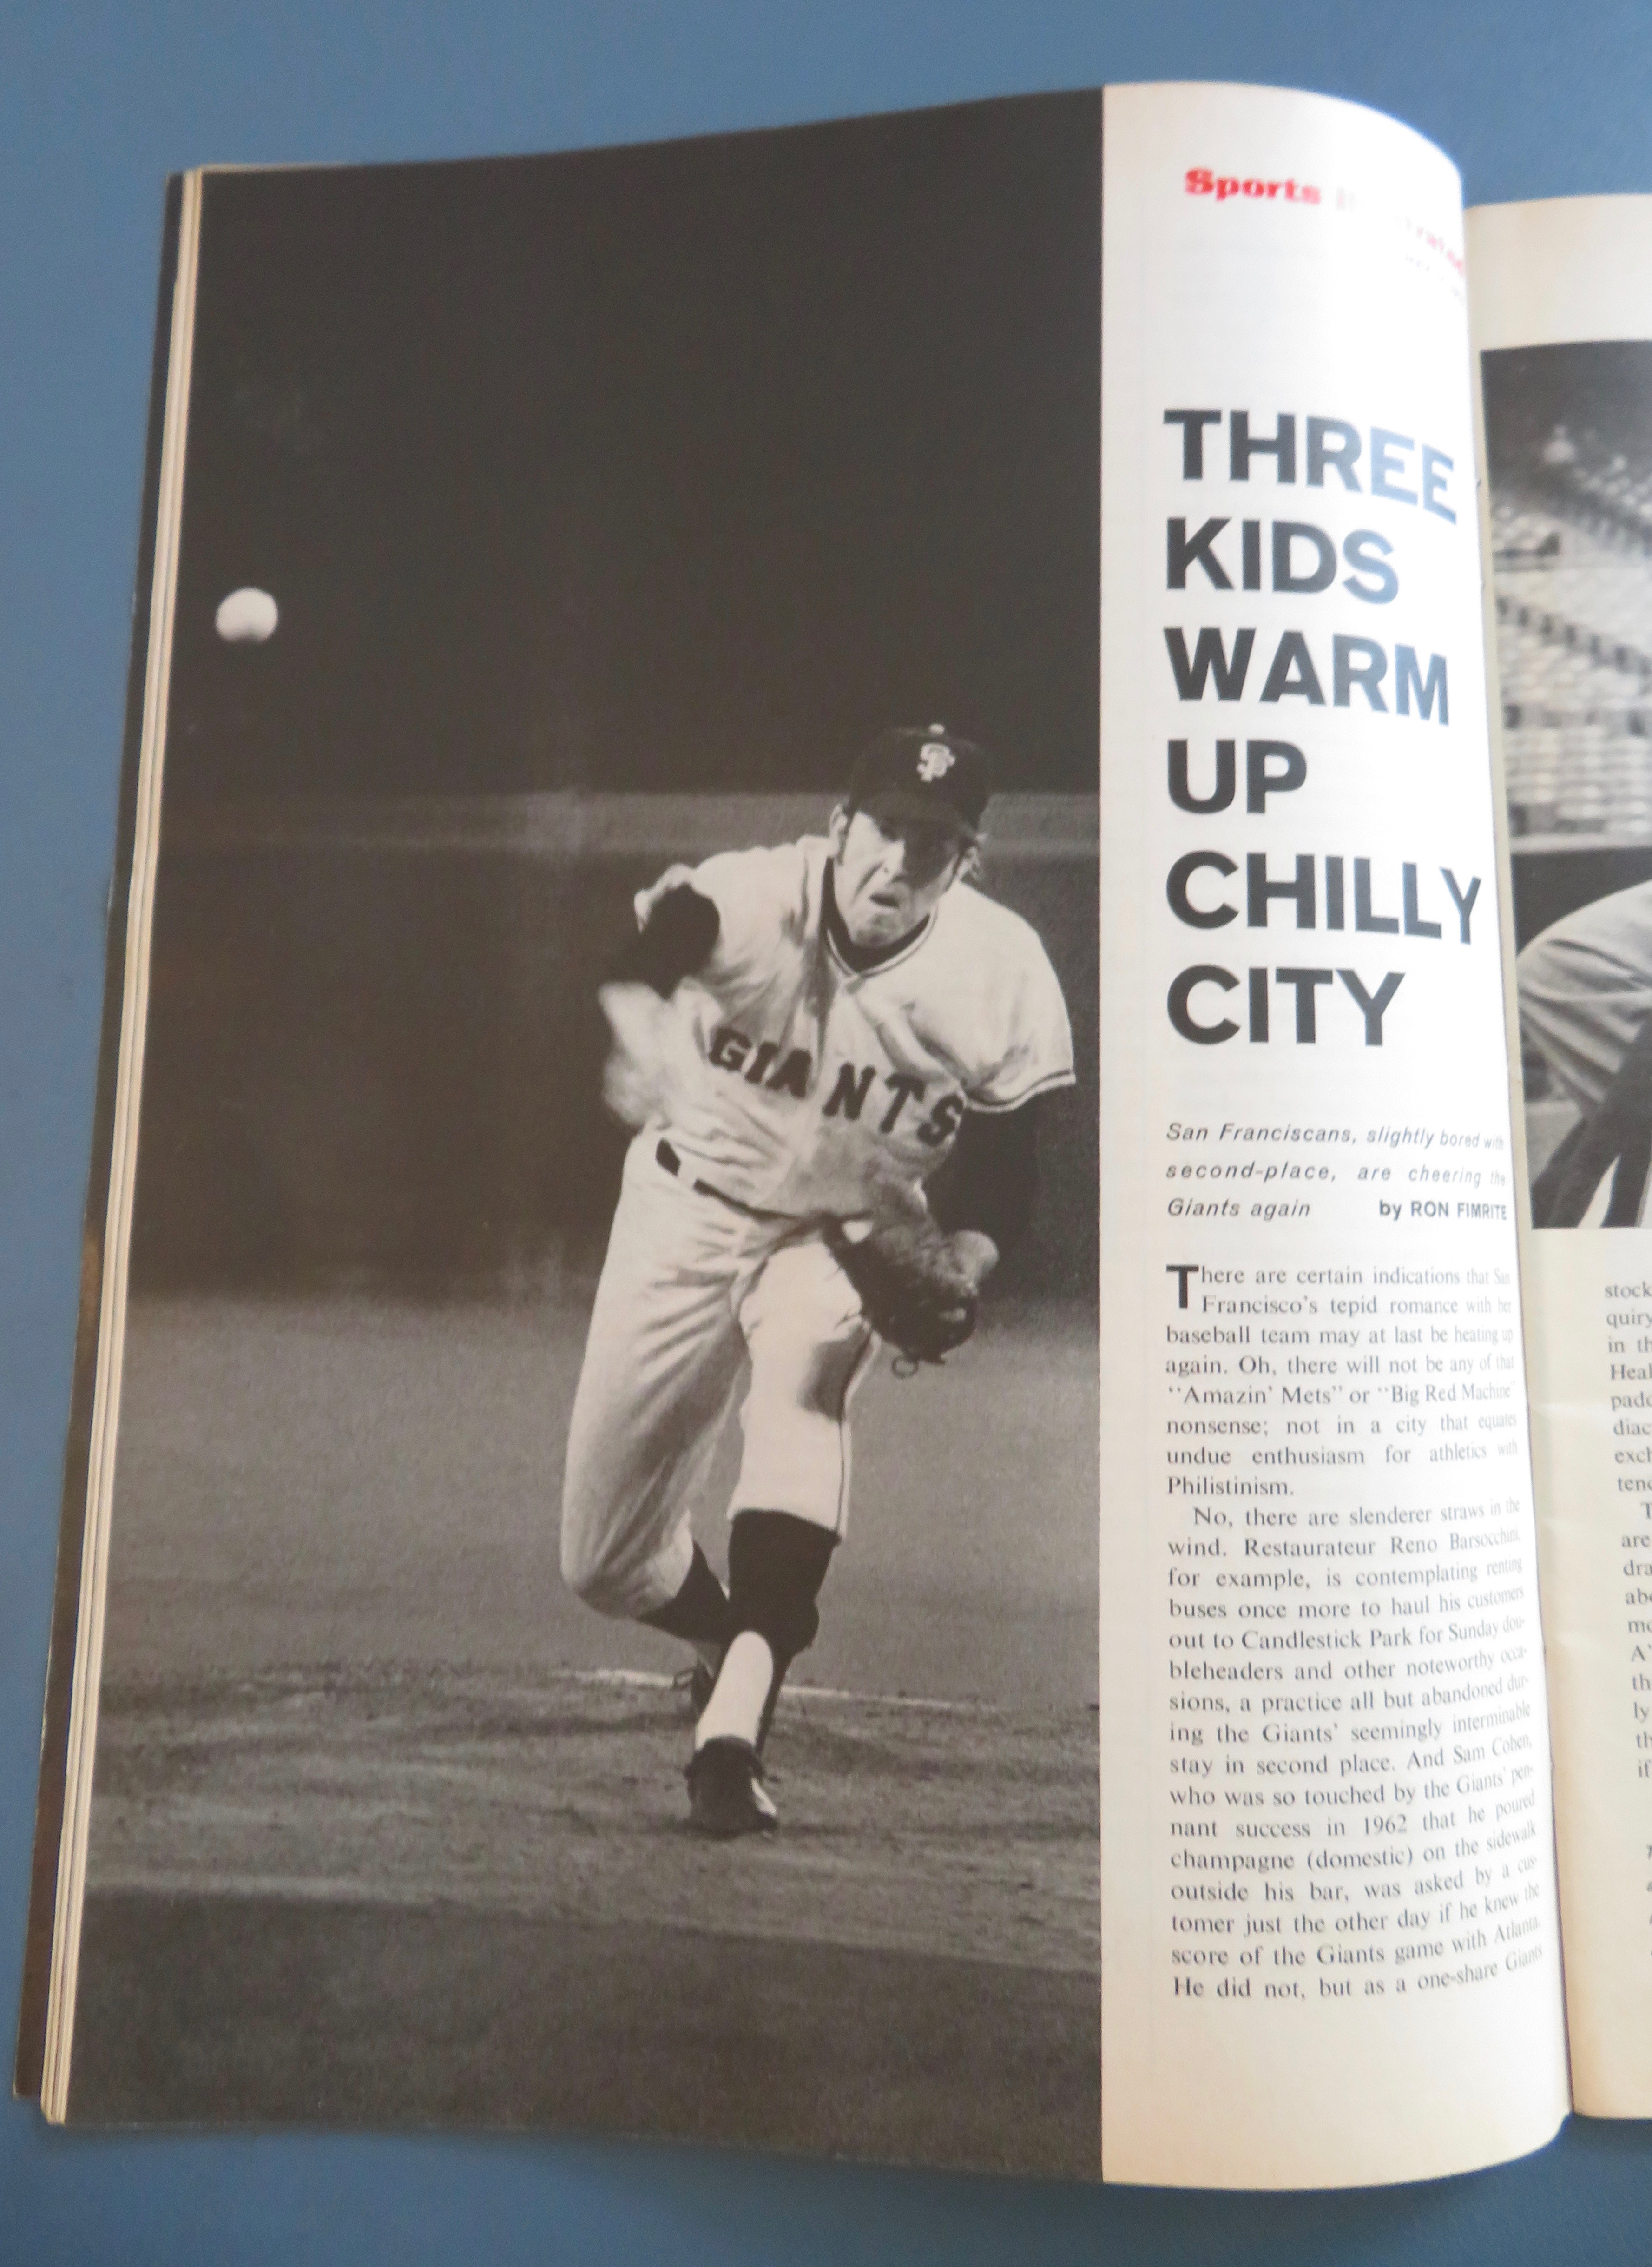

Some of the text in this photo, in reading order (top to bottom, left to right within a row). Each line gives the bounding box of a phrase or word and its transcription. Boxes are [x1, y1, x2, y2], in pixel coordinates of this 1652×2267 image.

[1184, 166, 1321, 202] Sports
[1163, 407, 1456, 525] THREE
[1165, 516, 1400, 606] KIDS
[1163, 626, 1450, 729] WARM
[1165, 738, 1308, 815] UP
[1165, 848, 1482, 945] CHILLY
[1165, 964, 1405, 1047] CITY
[709, 1026, 966, 1148] GIANTS
[1166, 1122, 1480, 1149] San Franciscans, slightly bored
[1165, 1160, 1481, 1189] second-place, are cheering
[1167, 1197, 1507, 1222] Giants again by RON FIMRITE
[1165, 1264, 1460, 1313] There are certain indications
[1202, 1295, 1458, 1317] Francisco's tepid romance
[1165, 1325, 1448, 1347] baseball team may at last be
[1165, 1355, 1474, 1377] again. Oh, there will not be any
[1349, 1389, 1370, 1404] or
[1425, 1384, 1456, 1402] Red
[1166, 1413, 1468, 1436] nonsense; not in a city that
[1166, 1441, 1487, 1465] undue enthusiasm for athletics
[1167, 1475, 1293, 1496] Philistinism.
[1193, 1503, 1485, 1528] No, there are slenderer straws
[1168, 1535, 1437, 1557] wind. Restaurateur Reno
[1168, 1560, 1477, 1591] for example, is contemplating
[1168, 1593, 1461, 1618] buses once more to haul his
[1168, 1619, 1499, 1650] out to Candlestick Park for Sunday
[1169, 1650, 1495, 1680] bleheaders and other noteworthy
[1168, 1677, 1503, 1715] sions, a practice all but abandoned
[1169, 1723, 1204, 1745] ing
[1217, 1723, 1249, 1743] the
[1350, 1718, 1442, 1743] seemingly
[1169, 1745, 1485, 1778] stay in second place. And Sam
[1169, 1786, 1215, 1806] who
[1224, 1791, 1264, 1807] was
[1272, 1790, 1296, 1806] so
[1304, 1784, 1384, 1805] touched
[1393, 1782, 1415, 1805] by
[1424, 1779, 1450, 1800] the
[1170, 1805, 1485, 1838] nant success in 1962 that he
[1170, 1837, 1479, 1873] champagne (domestic) on the
[1170, 1864, 1510, 1902] outside his bar, was asked by a
[1172, 1900, 1477, 1937] tomer just the other day if he
[1171, 1930, 1487, 1966] score of the Giants game with
[1173, 1963, 1498, 1999] He did not, but as a one-share
